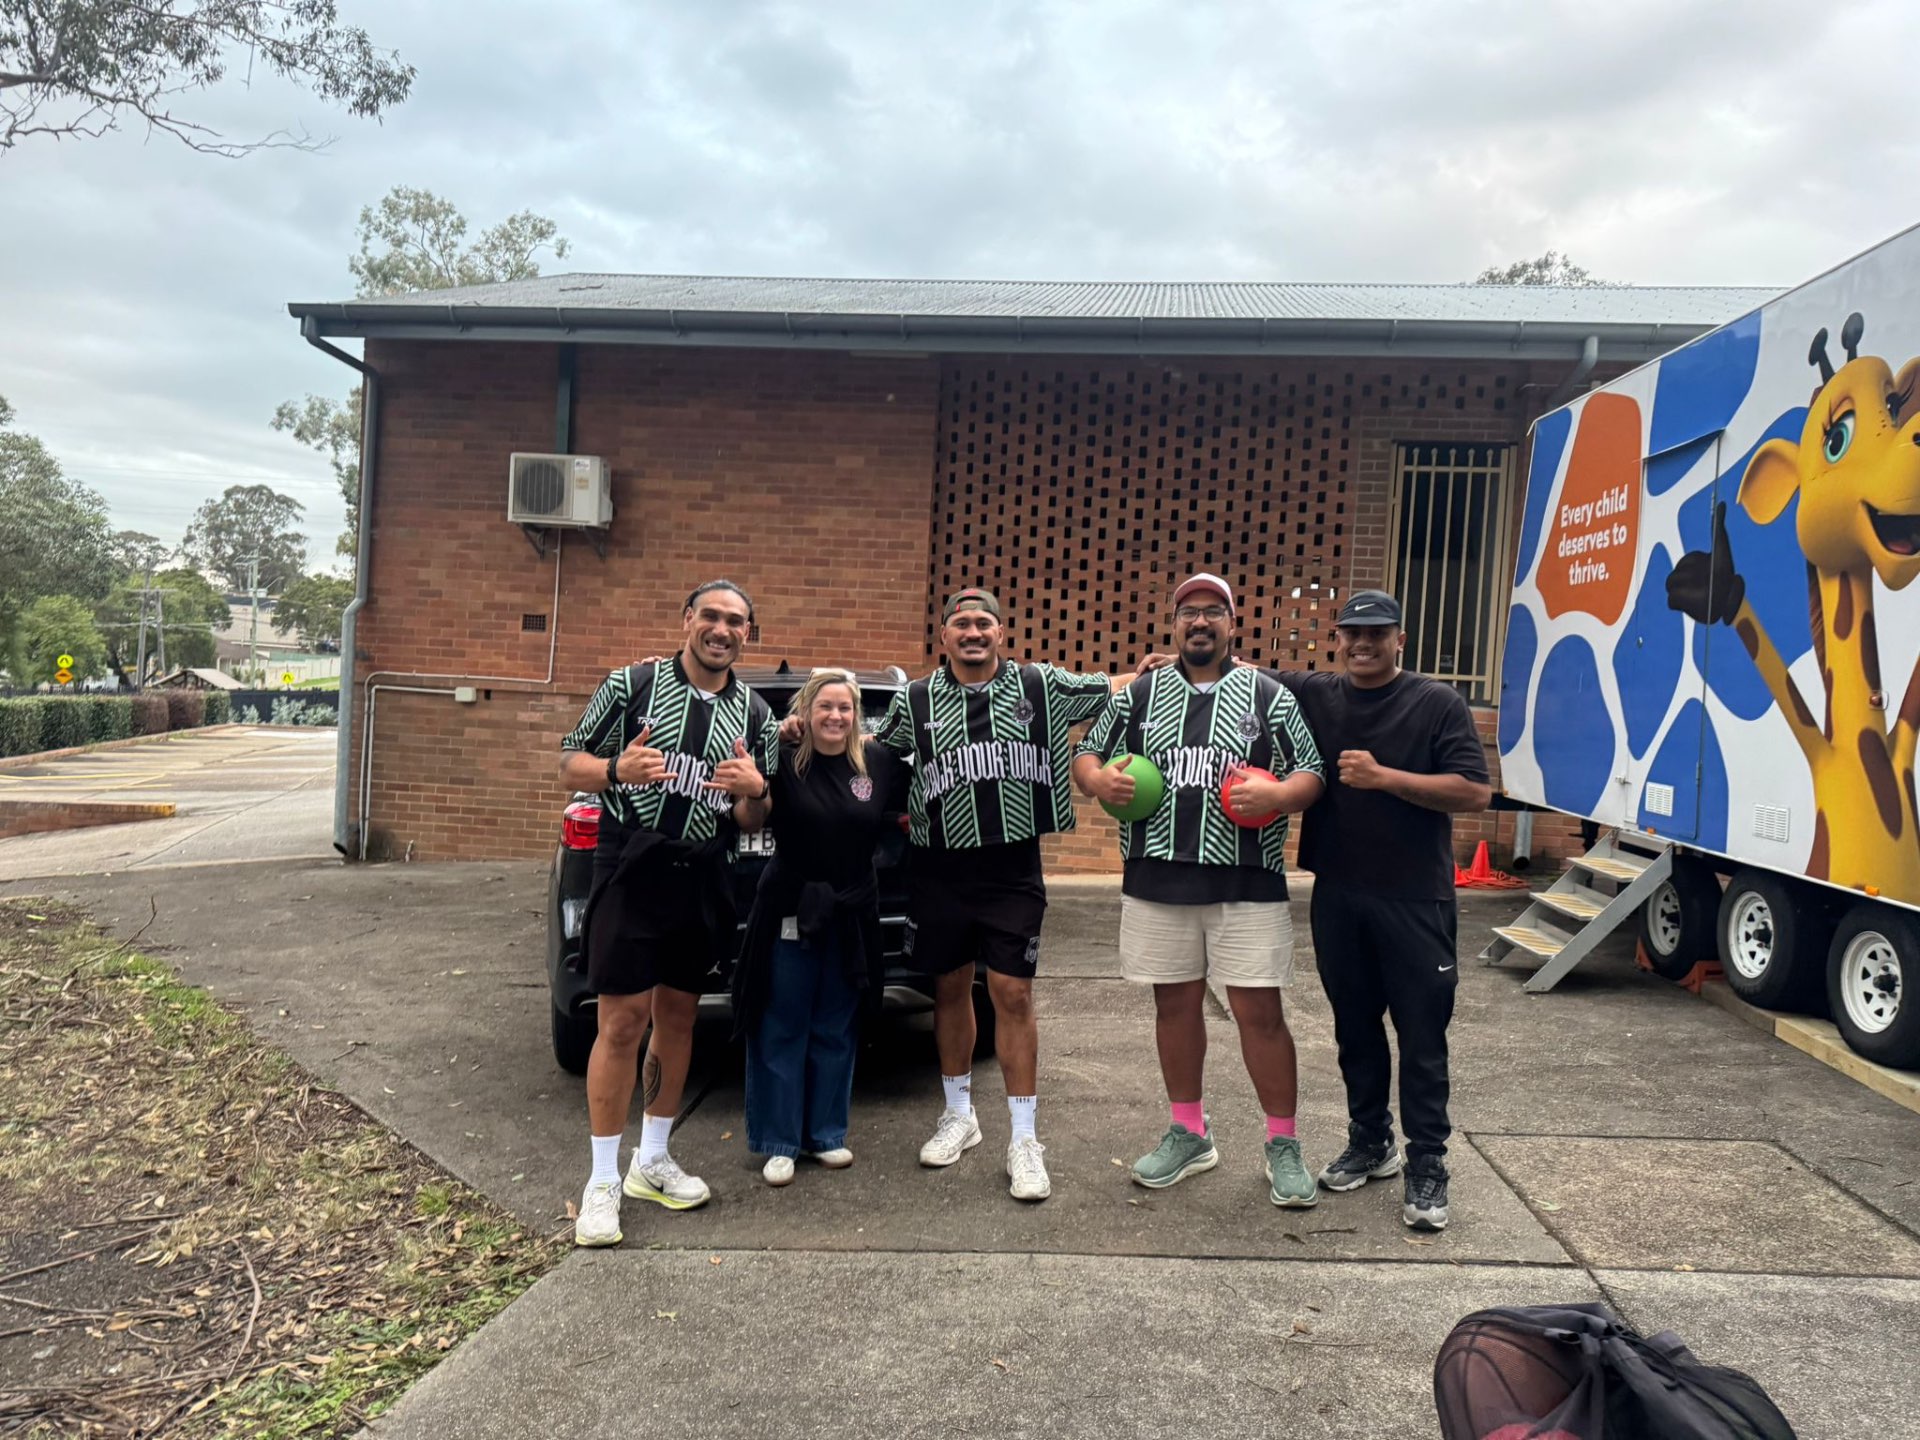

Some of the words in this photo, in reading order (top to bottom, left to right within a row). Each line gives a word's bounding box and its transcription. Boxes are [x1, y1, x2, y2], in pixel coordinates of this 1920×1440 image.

[1560, 502, 1594, 528] Every
[1595, 484, 1628, 518] child
[1558, 529, 1610, 558] deserves
[1612, 522, 1627, 546] to
[1568, 557, 1609, 586] thrive.
[656, 750, 709, 803] YOUR
[923, 750, 956, 804] TALK
[956, 740, 1006, 786] YOUR
[1006, 740, 1053, 788] WALK
[1165, 745, 1215, 790] YOUR
